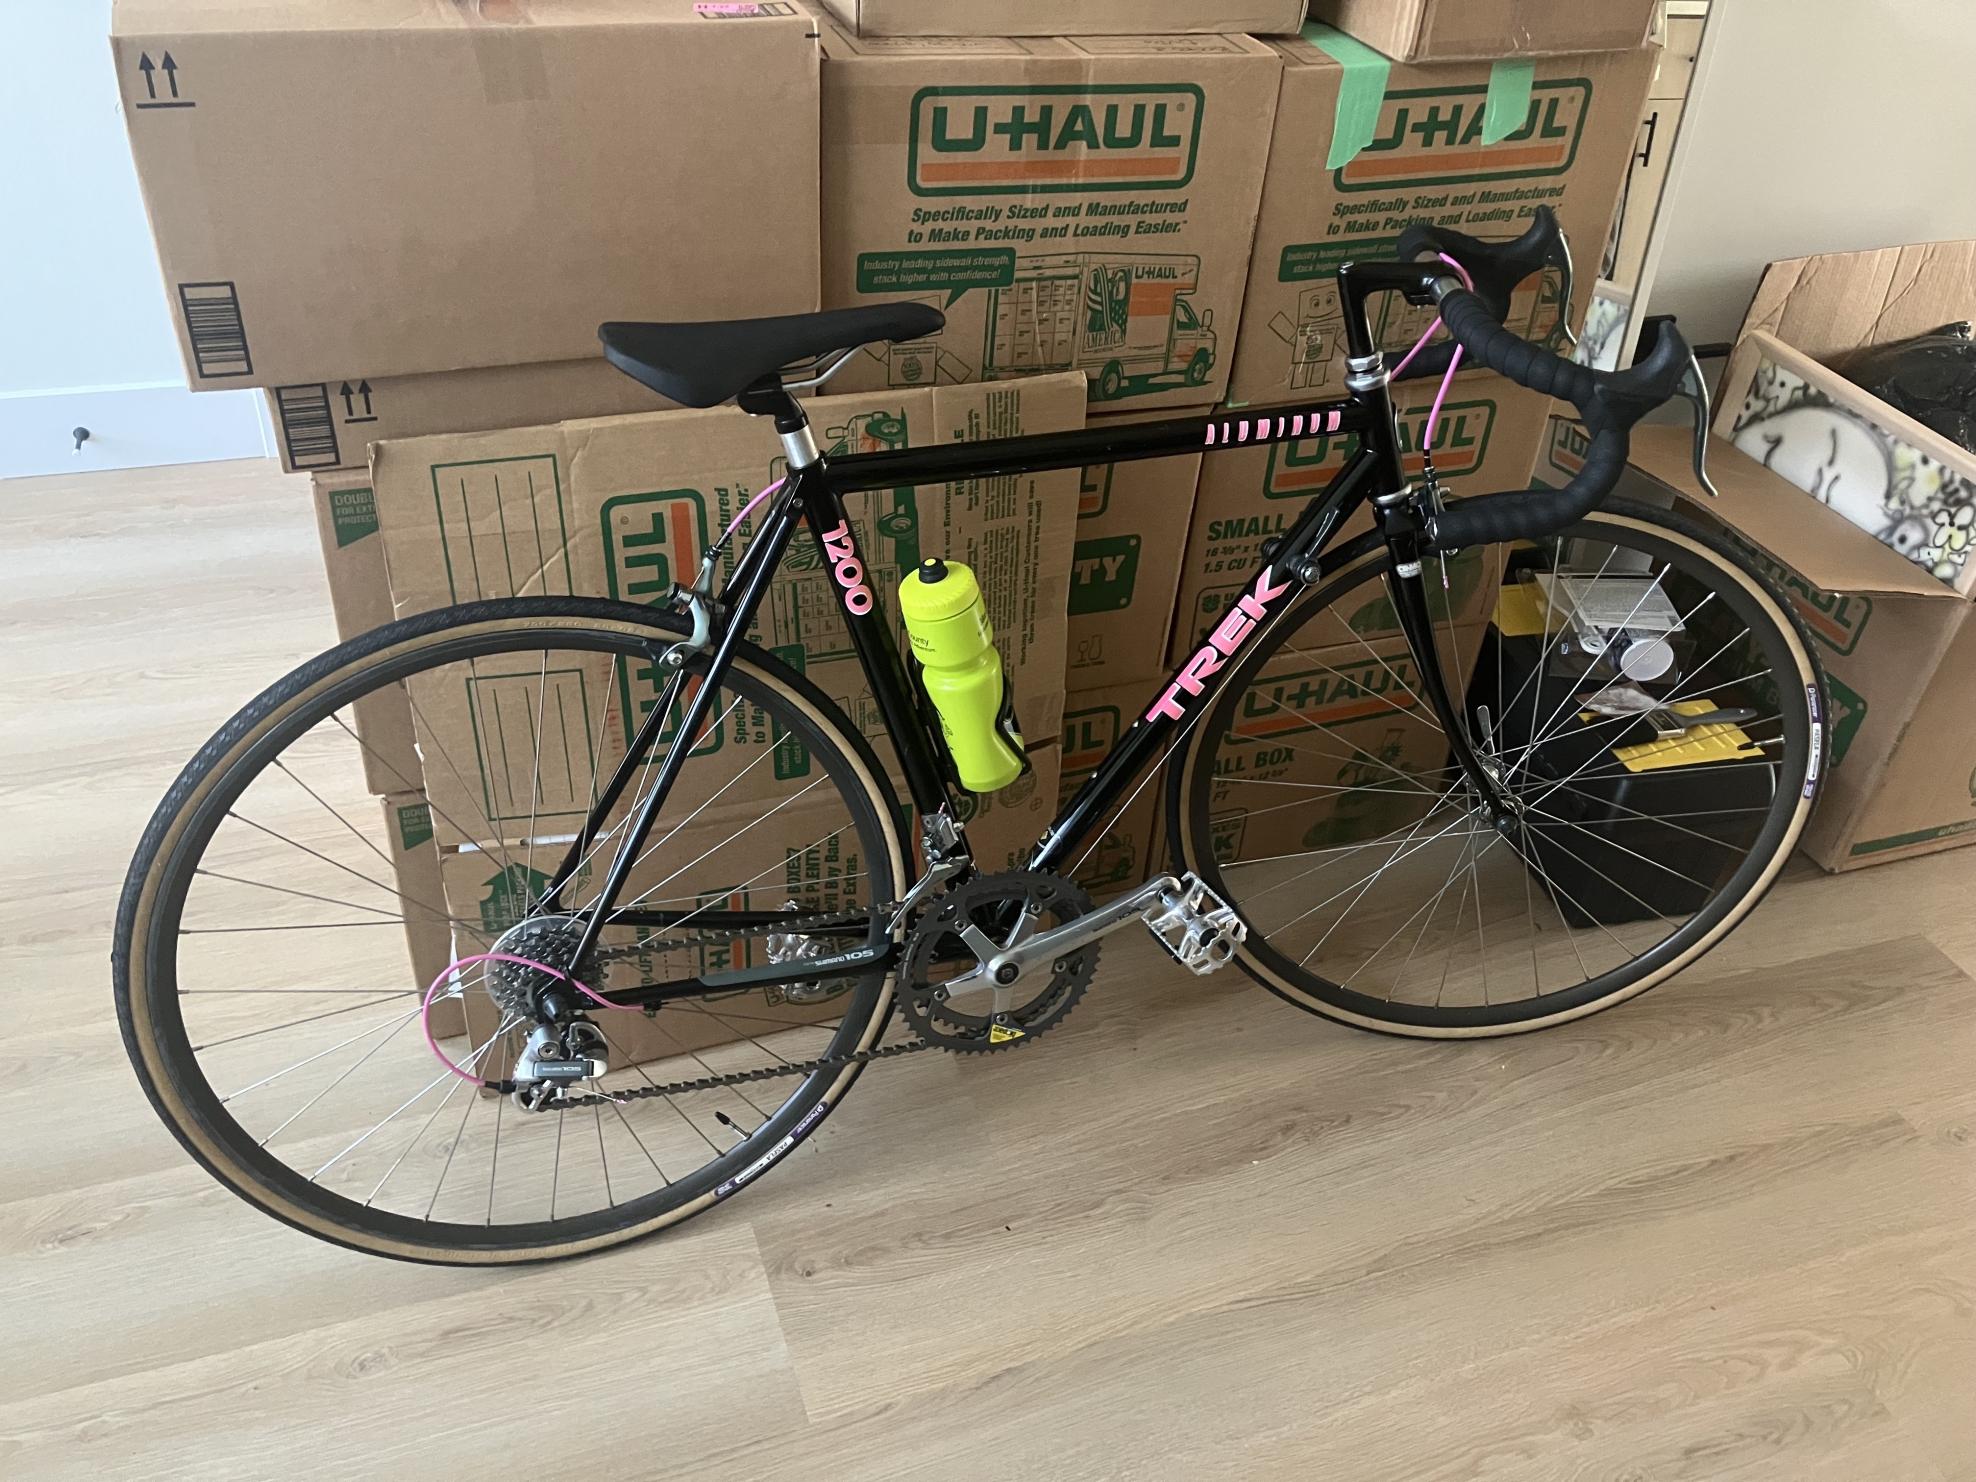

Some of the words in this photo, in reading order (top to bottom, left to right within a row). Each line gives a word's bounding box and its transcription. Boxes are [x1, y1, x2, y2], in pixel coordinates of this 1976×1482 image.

[910, 206, 1003, 224] Specifically
[1006, 204, 1049, 220] Sized
[1052, 203, 1083, 219] and
[1085, 199, 1189, 217] Manufactured
[1333, 197, 1409, 217] Specifically
[1412, 196, 1445, 210] Sized
[1450, 192, 1476, 207] and
[1478, 184, 1566, 204] Manufactured
[907, 228, 923, 244] to
[928, 226, 971, 244] Make
[975, 225, 1036, 244] Packing
[1039, 222, 1070, 239] and
[1072, 220, 1132, 240] Loading
[1326, 222, 1340, 236] to
[1344, 217, 1378, 234] Make
[1437, 210, 1463, 226] and
[1465, 207, 1515, 224] Loading
[863, 259, 901, 273] Industry
[902, 257, 934, 272] leading
[899, 271, 929, 285] higher
[929, 270, 949, 282] with
[1207, 513, 1289, 541] SMALL
[821, 518, 874, 616] 1200
[1074, 555, 1126, 585] TY
[1227, 557, 1247, 572] CU
[1144, 564, 1292, 725] TREK
[1254, 747, 1296, 769] BOX
[845, 948, 875, 961] 105
